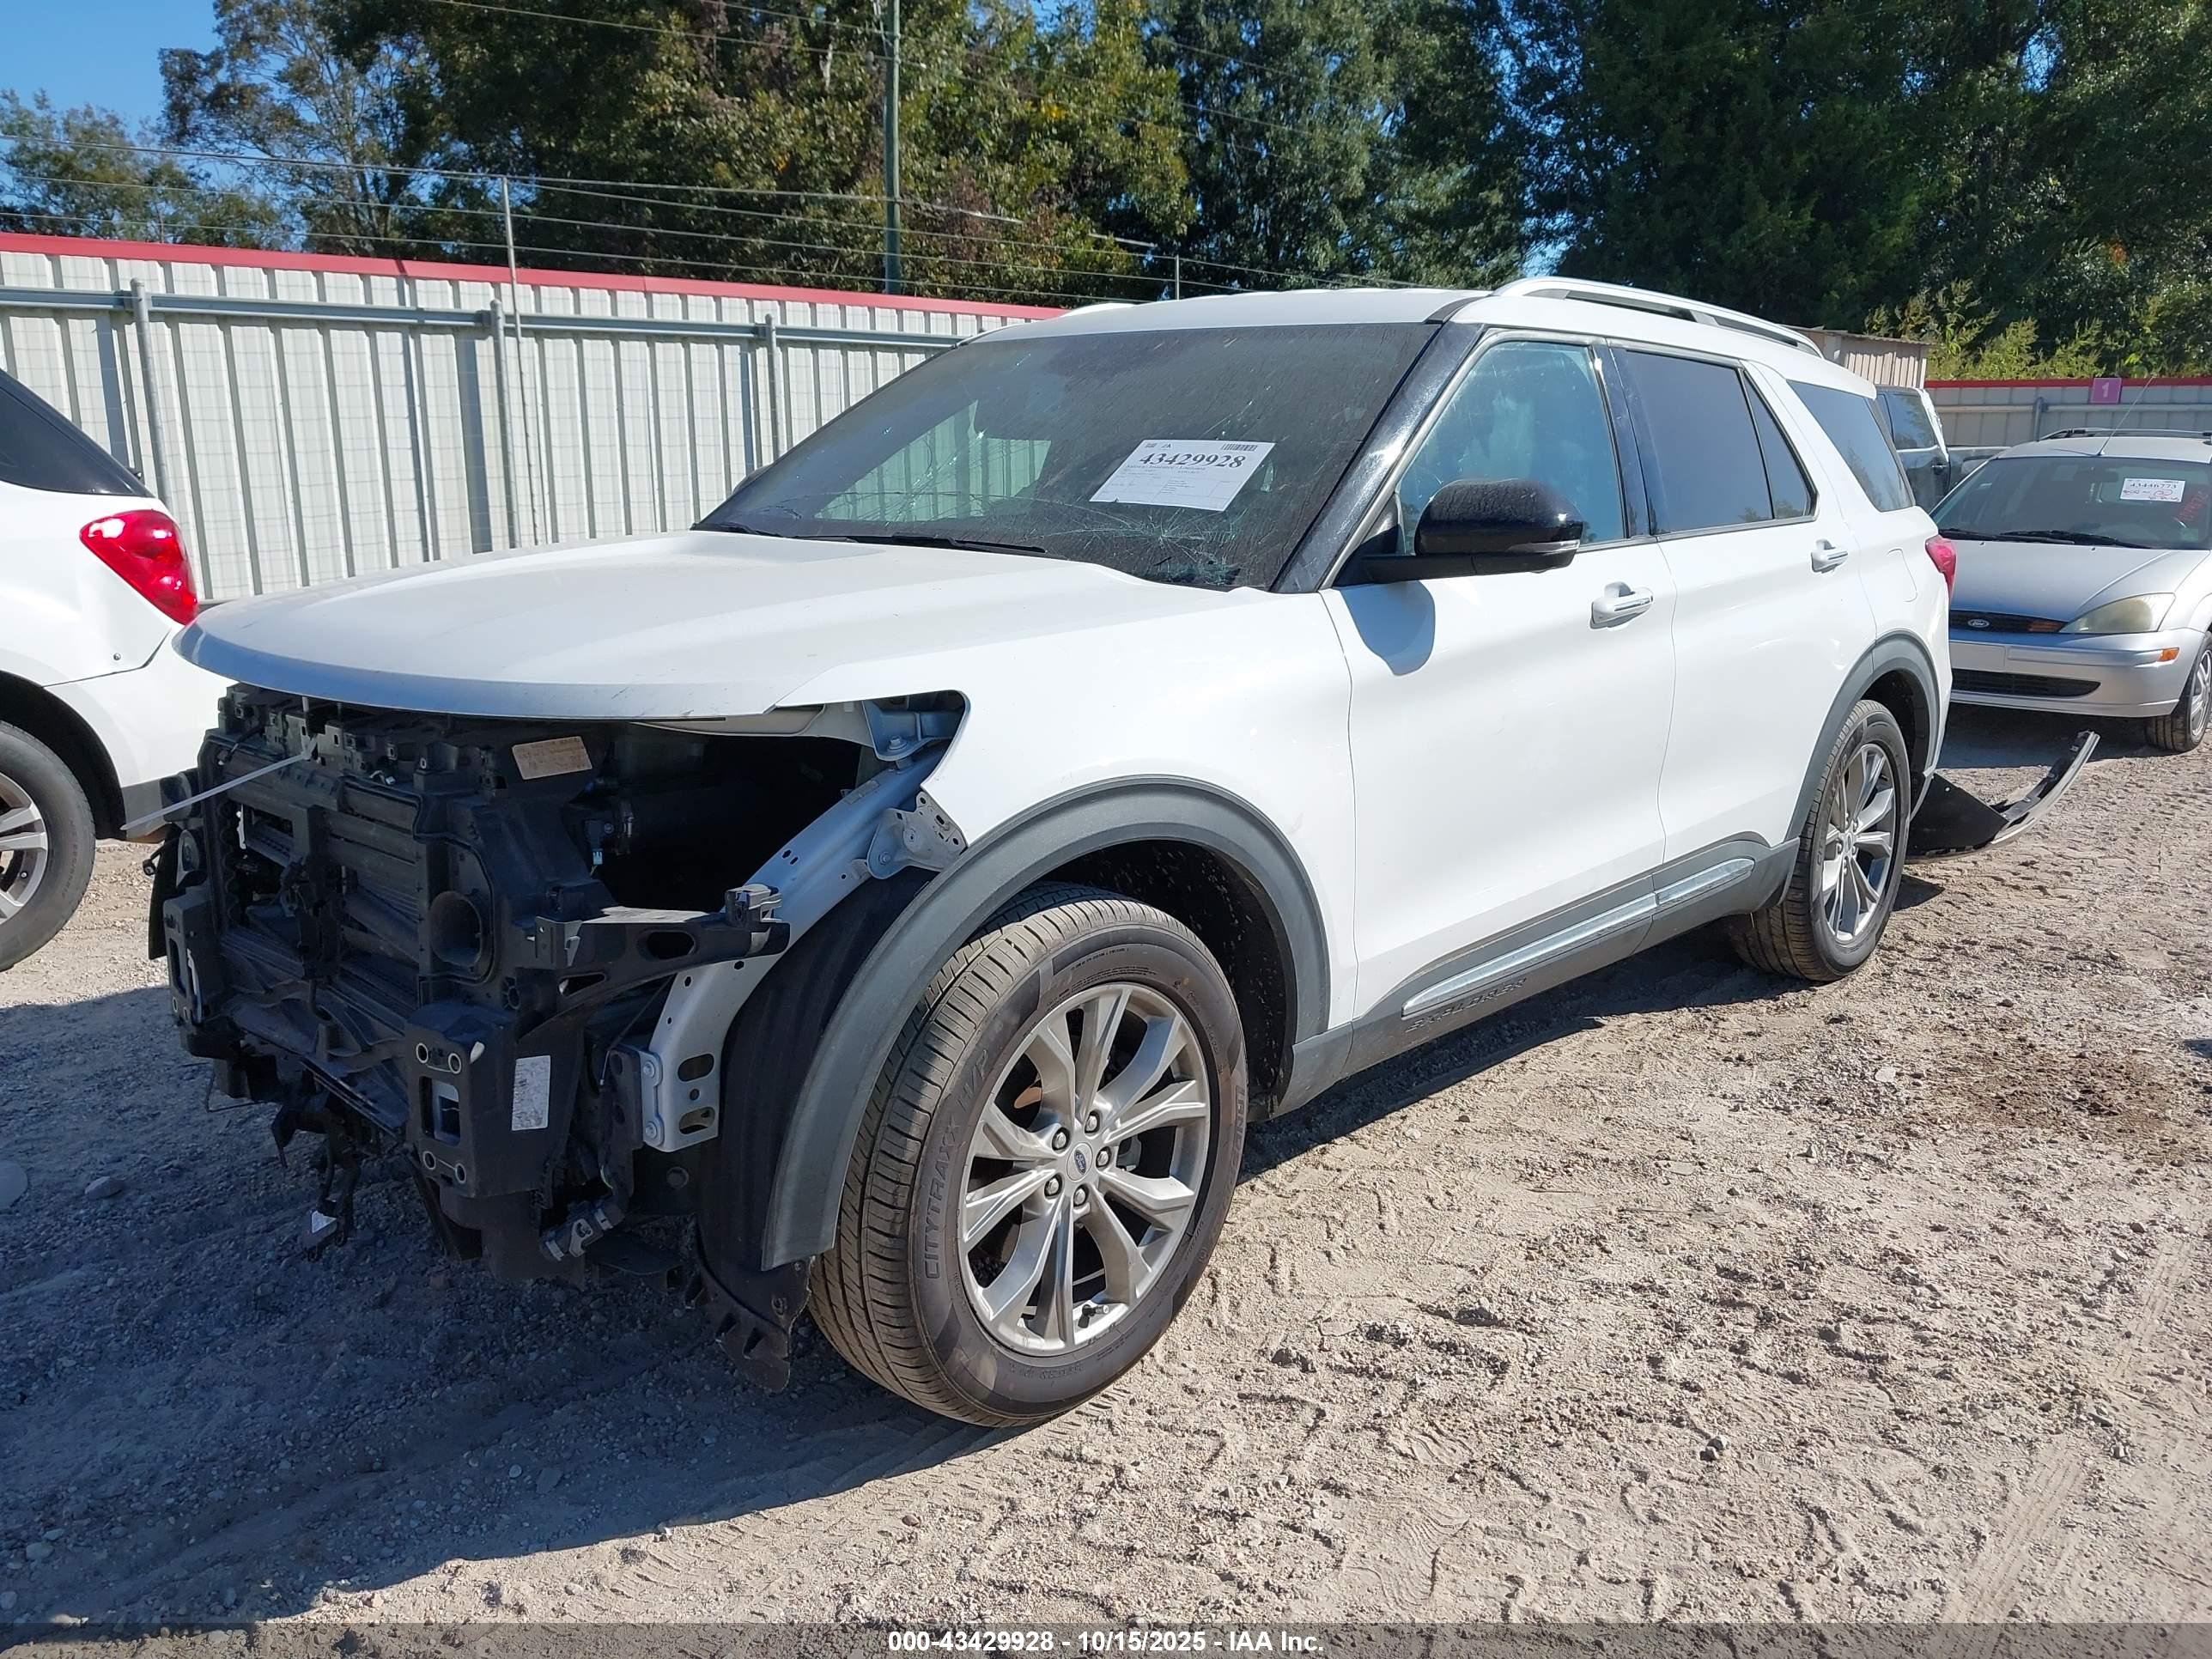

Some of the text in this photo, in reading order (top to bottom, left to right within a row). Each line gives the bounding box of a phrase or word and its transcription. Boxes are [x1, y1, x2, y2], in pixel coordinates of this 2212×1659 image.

[2101, 382, 2110, 398] 1
[1139, 453, 1247, 469] 43429928
[1405, 977, 1527, 1033] EXPLORER
